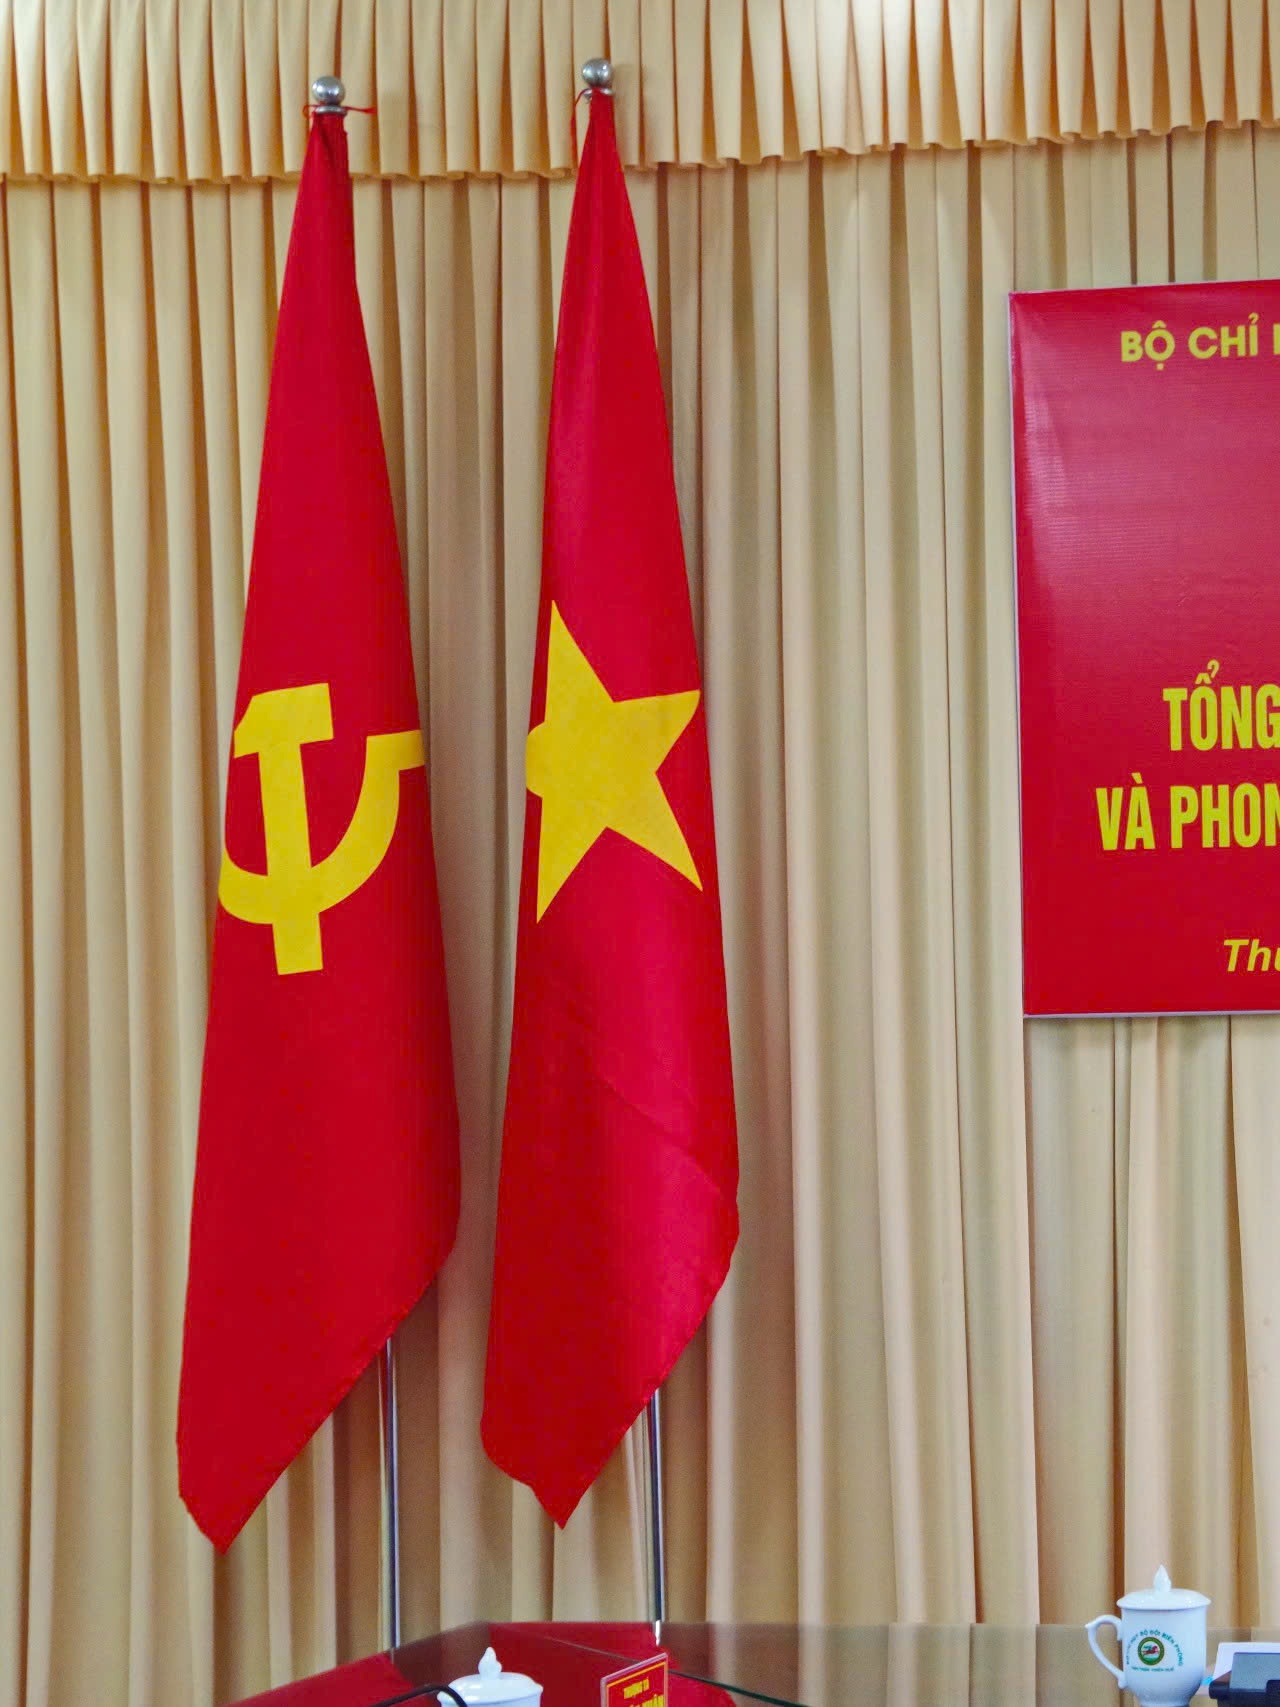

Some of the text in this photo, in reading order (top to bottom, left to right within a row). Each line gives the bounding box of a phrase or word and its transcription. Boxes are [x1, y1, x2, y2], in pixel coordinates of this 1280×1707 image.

[1120, 321, 1175, 370] BỘ
[1188, 313, 1259, 359] CHỈ
[1095, 772, 1156, 851] VÀ
